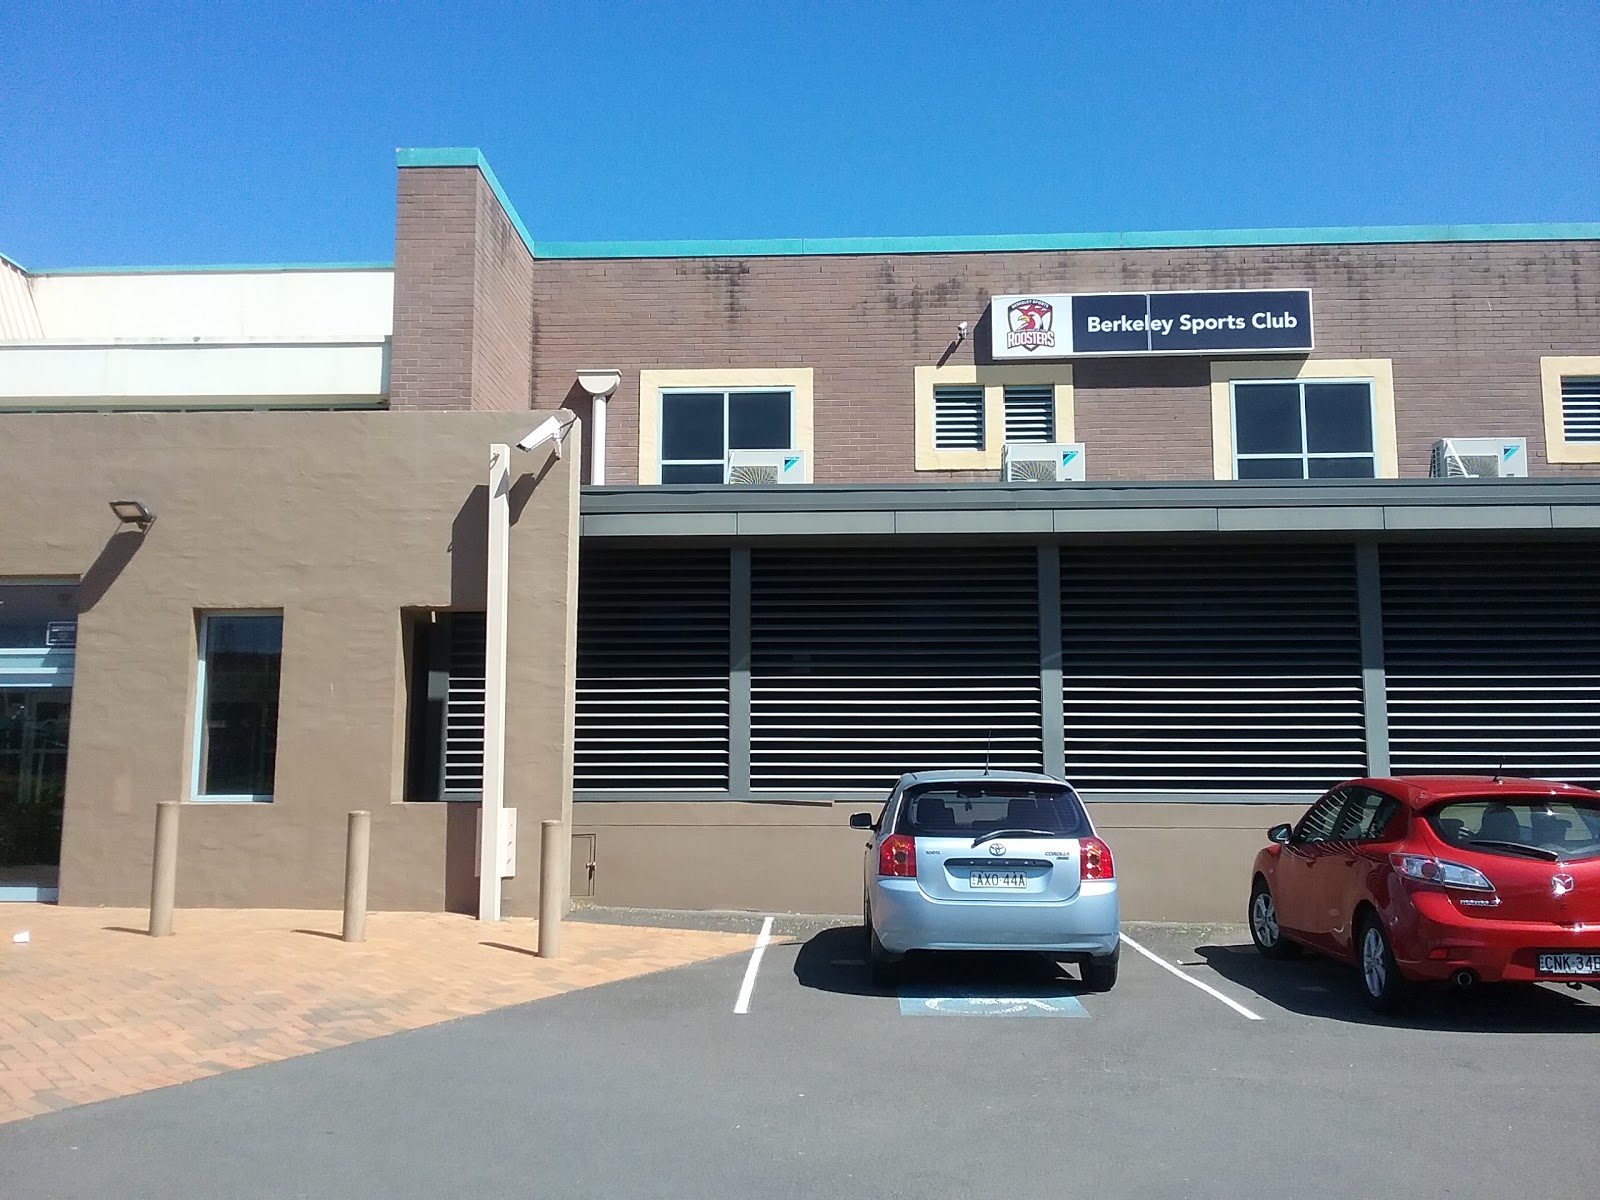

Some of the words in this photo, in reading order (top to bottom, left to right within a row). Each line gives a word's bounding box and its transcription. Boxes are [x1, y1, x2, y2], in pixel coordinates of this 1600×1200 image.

[1087, 314, 1174, 335] Berkeley
[1179, 314, 1246, 334] Sports
[1251, 311, 1298, 329] Club
[1008, 331, 1054, 348] ROOSTERS
